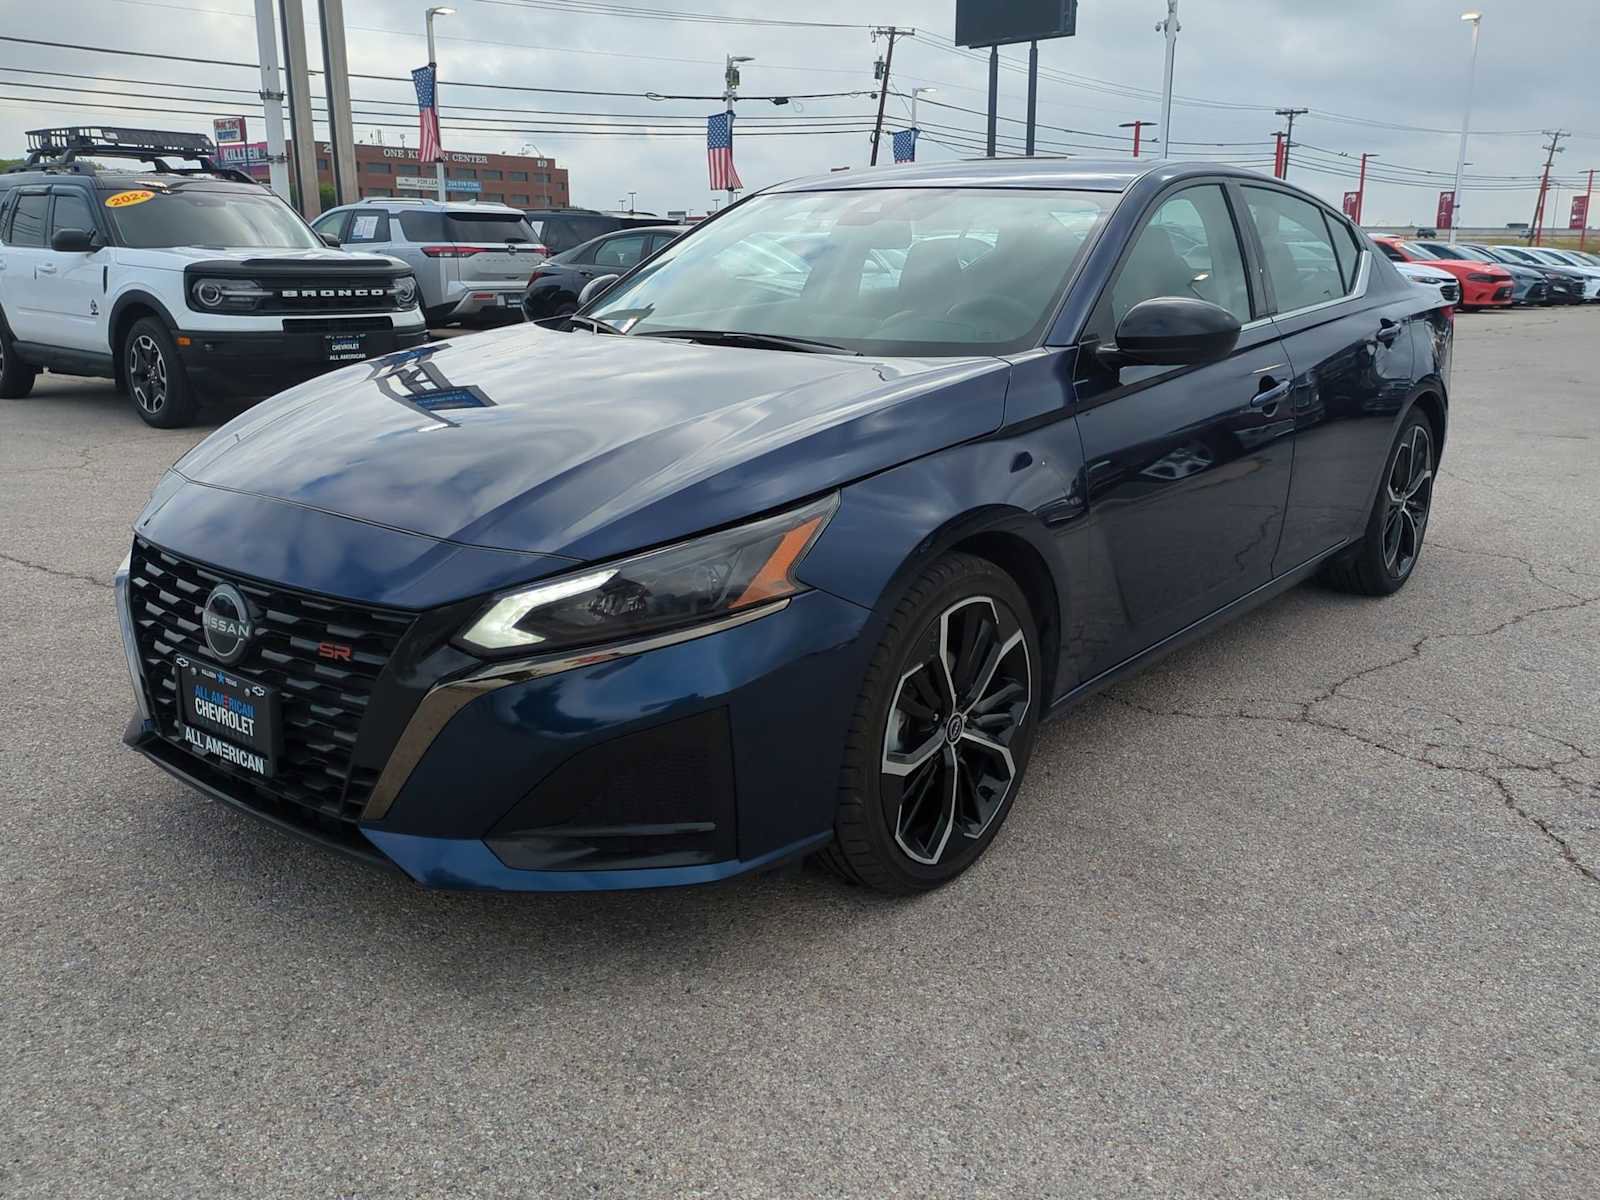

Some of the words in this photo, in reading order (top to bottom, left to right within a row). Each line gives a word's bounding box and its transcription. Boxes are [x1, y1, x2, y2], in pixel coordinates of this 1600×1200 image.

[383, 148, 405, 158] ONE
[452, 153, 488, 164] CENTER
[282, 289, 384, 297] BRONCO
[203, 612, 250, 638] NISSAN
[319, 641, 352, 662] SR
[195, 685, 209, 700] ALL
[211, 691, 256, 718] AMERICAN
[195, 697, 255, 737] CHEVROLET
[185, 727, 204, 748] ALL
[206, 736, 265, 775] AMERICAN
